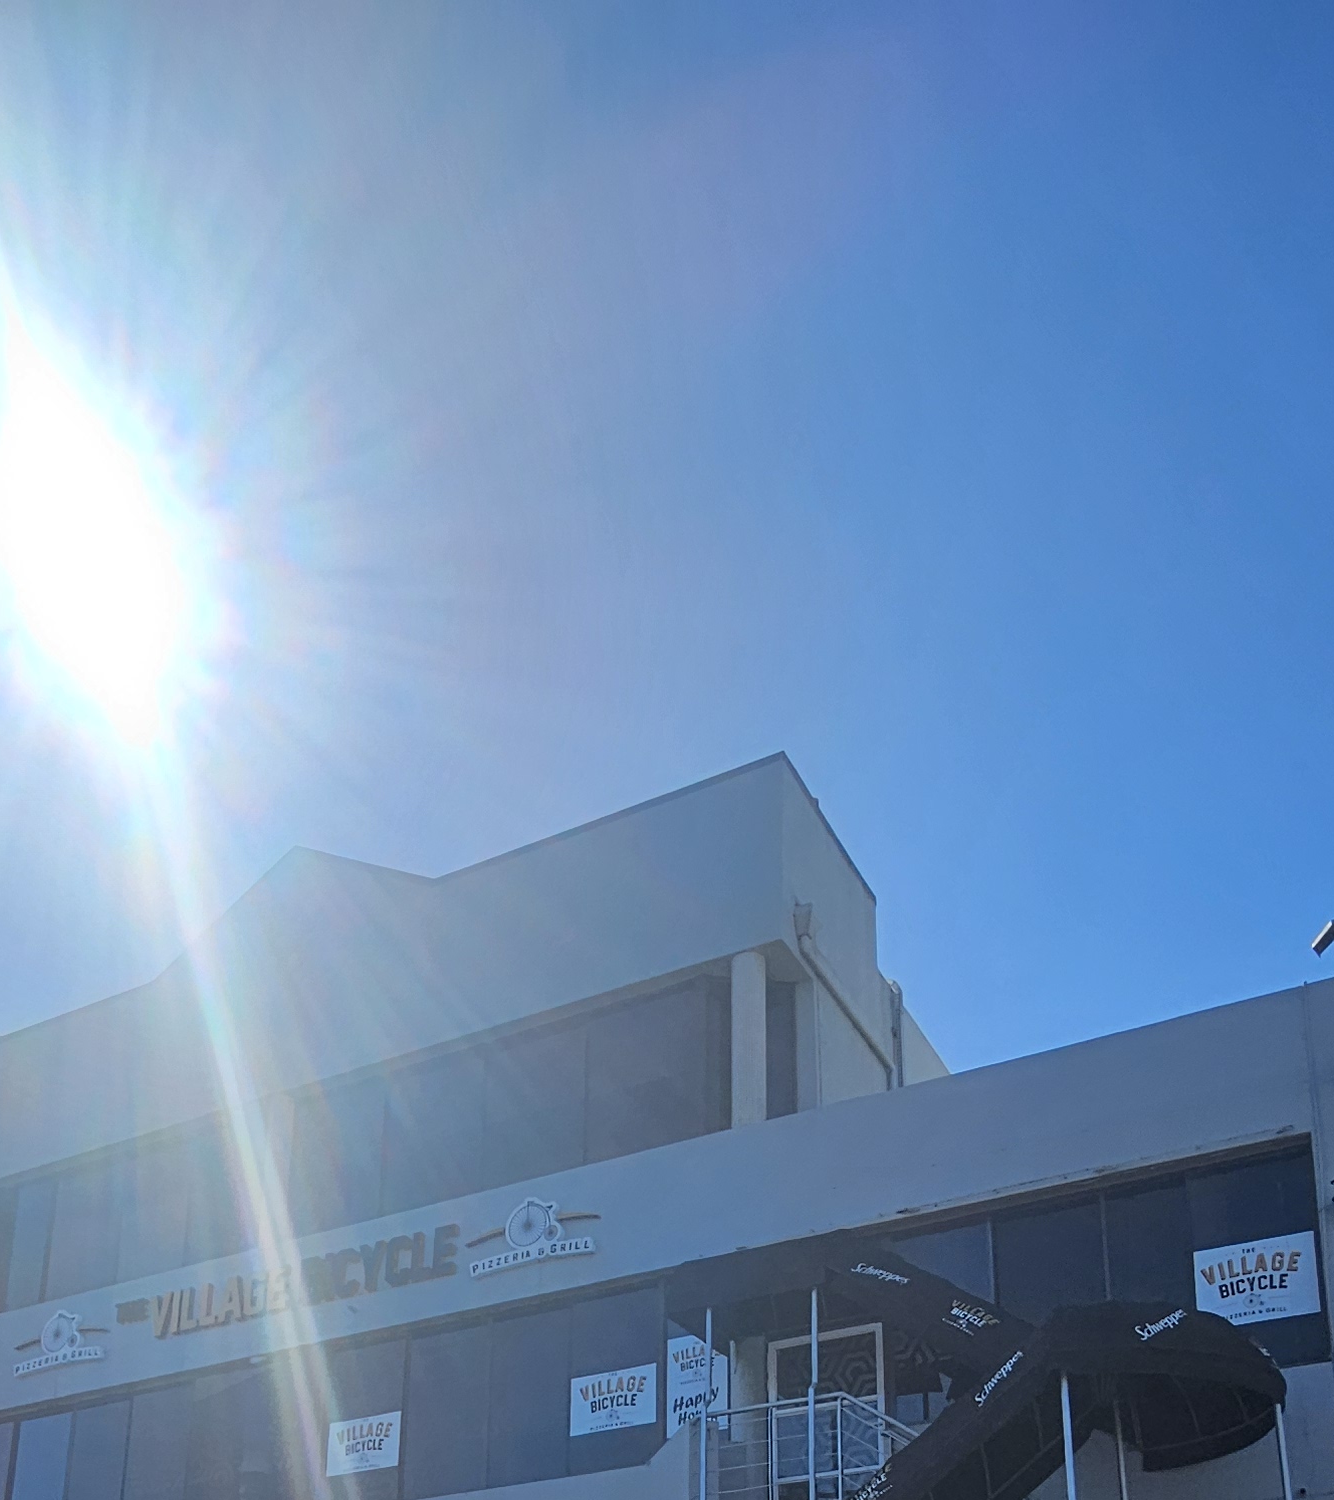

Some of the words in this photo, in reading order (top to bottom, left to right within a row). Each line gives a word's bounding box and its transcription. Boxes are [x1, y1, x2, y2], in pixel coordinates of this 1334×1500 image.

[472, 1250, 531, 1274] PIZZERIA
[550, 1240, 590, 1254] GRILL
[1200, 1251, 1302, 1286] VILLAGE
[851, 1262, 911, 1285] Schweppes
[1218, 1273, 1289, 1299] BICYCLE
[950, 1307, 987, 1328] BICYCLE
[1134, 1309, 1188, 1341] Schweppe
[15, 1355, 59, 1374] PIZZERIA
[71, 1348, 99, 1359] GRILL
[680, 1356, 715, 1372] BICYCE
[579, 1375, 647, 1402] VILLAGE
[590, 1393, 637, 1413] BICYCLE
[336, 1422, 393, 1445] VILLAGE
[345, 1439, 385, 1456] BICYCLE
